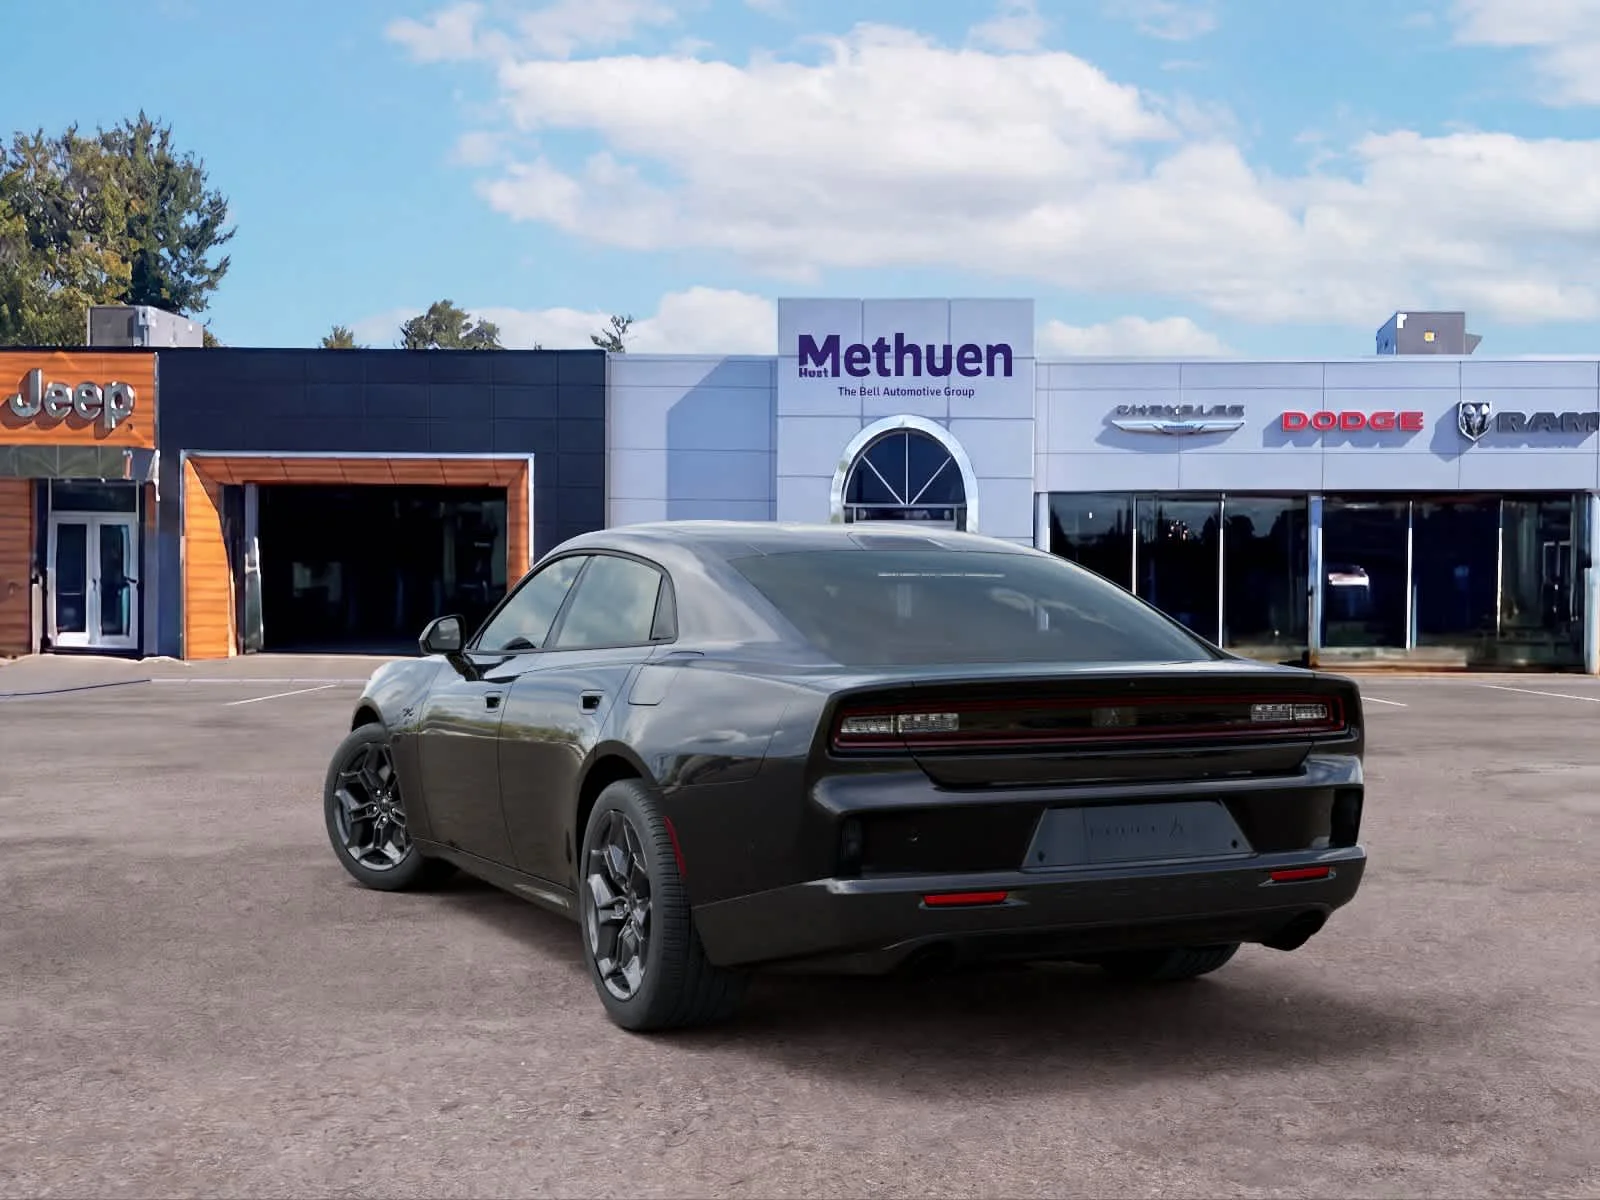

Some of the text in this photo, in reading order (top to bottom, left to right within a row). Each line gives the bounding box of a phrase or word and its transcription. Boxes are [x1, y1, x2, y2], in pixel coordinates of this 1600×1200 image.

[799, 333, 1013, 377] Methuen
[9, 368, 136, 430] Jeep
[838, 386, 975, 399] The Bell Automotive Group
[1281, 411, 1424, 431] DODGE
[1497, 411, 1600, 433] RAM
